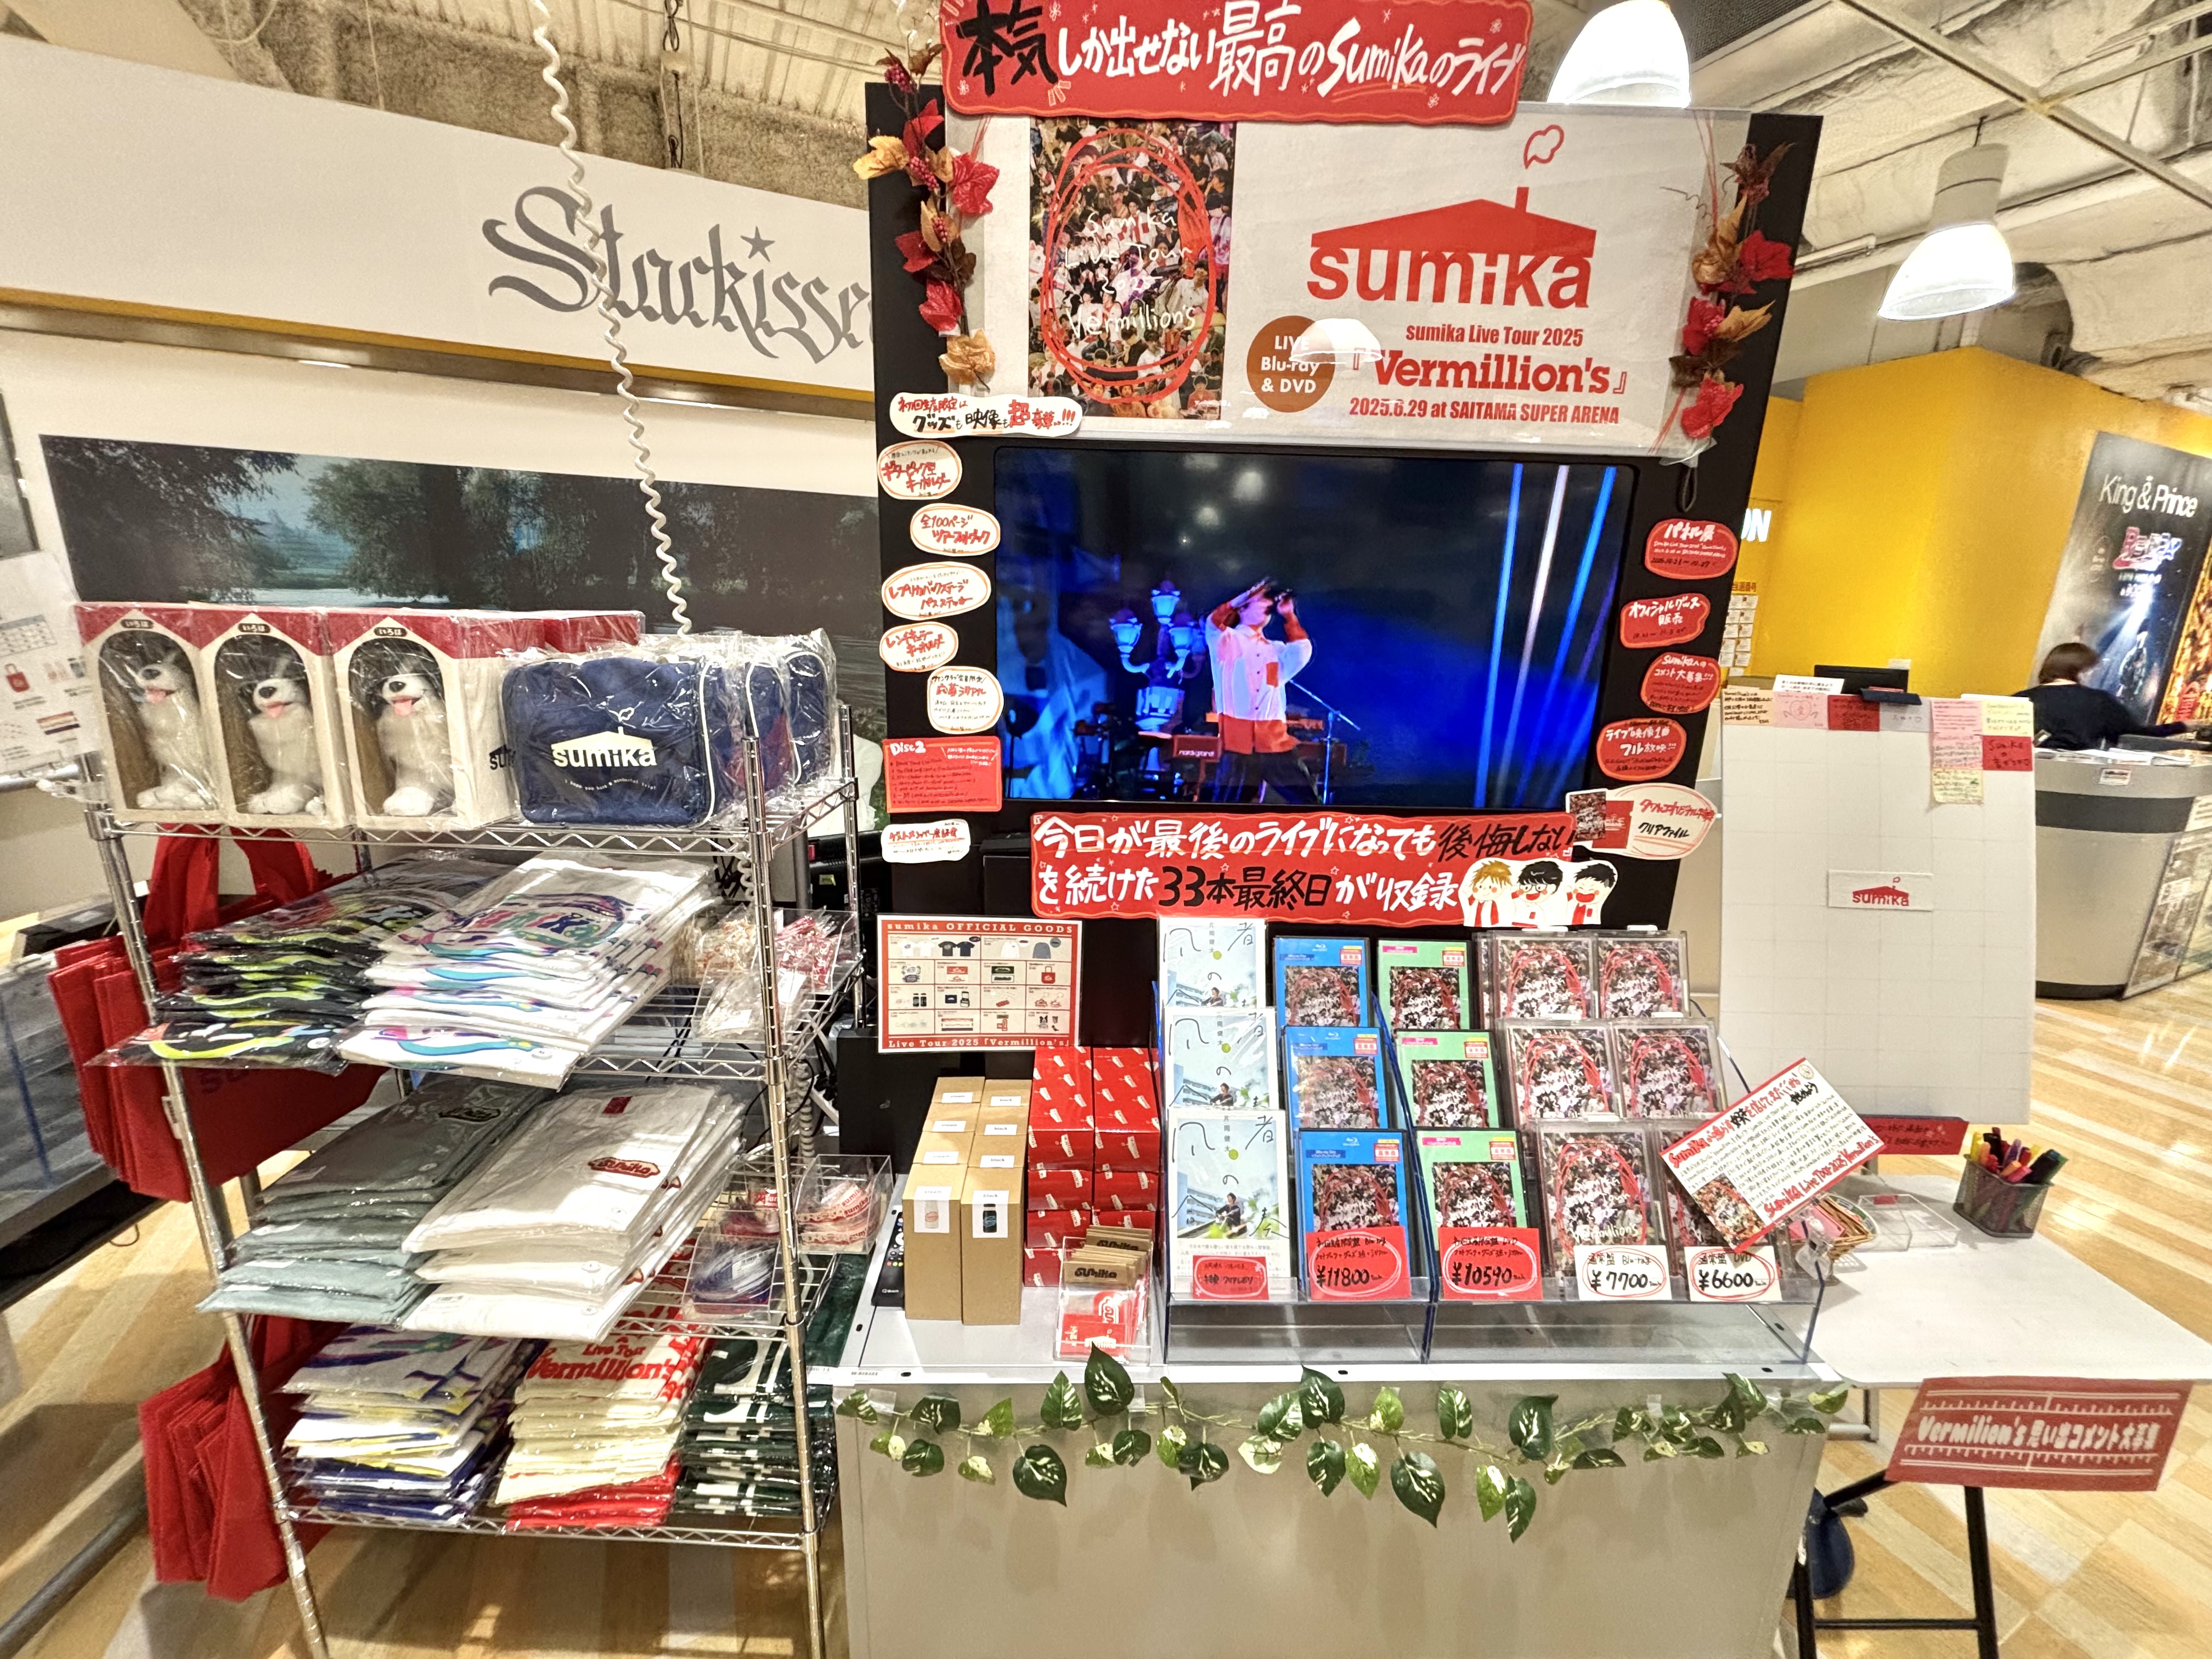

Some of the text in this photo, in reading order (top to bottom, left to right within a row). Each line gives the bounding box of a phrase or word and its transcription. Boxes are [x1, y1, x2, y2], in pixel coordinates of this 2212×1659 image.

[1306, 247, 1593, 309] sumika
[1274, 335, 1310, 351] LIVE
[1406, 324, 1583, 347] sumika Live Tour 2025
[1261, 357, 1319, 376] Blu-ray
[1261, 379, 1317, 393] & DVD
[1350, 398, 1620, 424] 2025.6.29 at SAITAMA SUPER ARENA
[2098, 474, 2198, 518] King & Prince
[552, 747, 657, 768] sumika
[1852, 892, 1910, 907] sumika
[946, 923, 1016, 932] OFFICIAL
[1024, 924, 1073, 933] GOODS
[1734, 1252, 1752, 1262] DVD
[1317, 1265, 1370, 1287] ¥11800
[1590, 1269, 1648, 1292] ¥7700
[1699, 1269, 1754, 1291] ¥6600
[527, 1357, 676, 1380] Vermillion's
